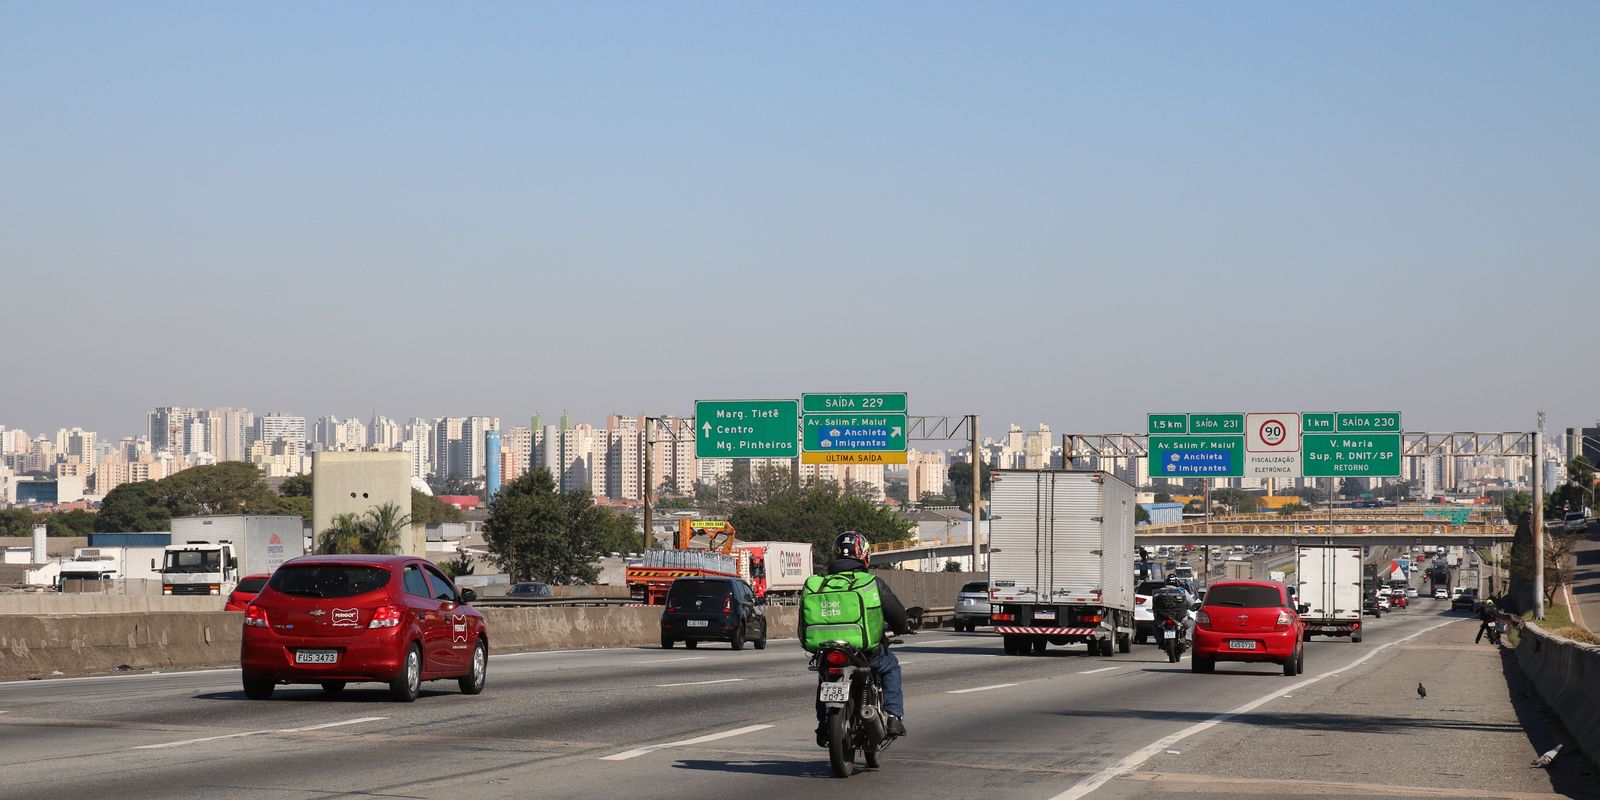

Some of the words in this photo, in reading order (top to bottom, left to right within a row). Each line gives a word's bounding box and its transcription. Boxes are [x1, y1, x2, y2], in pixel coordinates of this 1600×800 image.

[826, 396, 855, 407] SAÍDA
[863, 398, 884, 407] 229
[717, 409, 747, 420] Marg.
[752, 409, 779, 418] Tietê
[825, 418, 850, 426] Salim
[862, 418, 887, 426] Maluf
[1167, 420, 1182, 428] km
[1195, 418, 1218, 428] SAÍDA
[1223, 419, 1238, 428] 231
[1307, 418, 1311, 426] 1
[1314, 418, 1329, 426] km
[1343, 416, 1370, 426] SAÍDA
[1374, 417, 1395, 426] 230
[717, 426, 754, 434] Centro
[844, 428, 887, 437] Anchieta
[1265, 426, 1281, 436] 90
[717, 441, 736, 451] Mg.
[740, 441, 792, 449] Pinheiros
[835, 439, 887, 449] Imigrantes
[1330, 440, 1340, 448] V.
[1343, 440, 1373, 448] Maria
[826, 452, 854, 462] ÚLTIMA
[858, 453, 883, 462] SAÍDA
[1183, 453, 1223, 461] Anchieta
[1251, 456, 1294, 464] FISCALIZAÇÃO
[1309, 452, 1331, 462] Sup.
[1335, 452, 1345, 460] R.
[1348, 451, 1393, 460] DNIT/SP
[1179, 464, 1227, 473] Imigrantes
[1255, 465, 1291, 473] ELETRÔNICA
[1333, 464, 1369, 472] RETORNO
[821, 600, 840, 608] Uber
[821, 608, 841, 617] Eats
[298, 654, 313, 662] FUS
[315, 654, 335, 662] 3473
